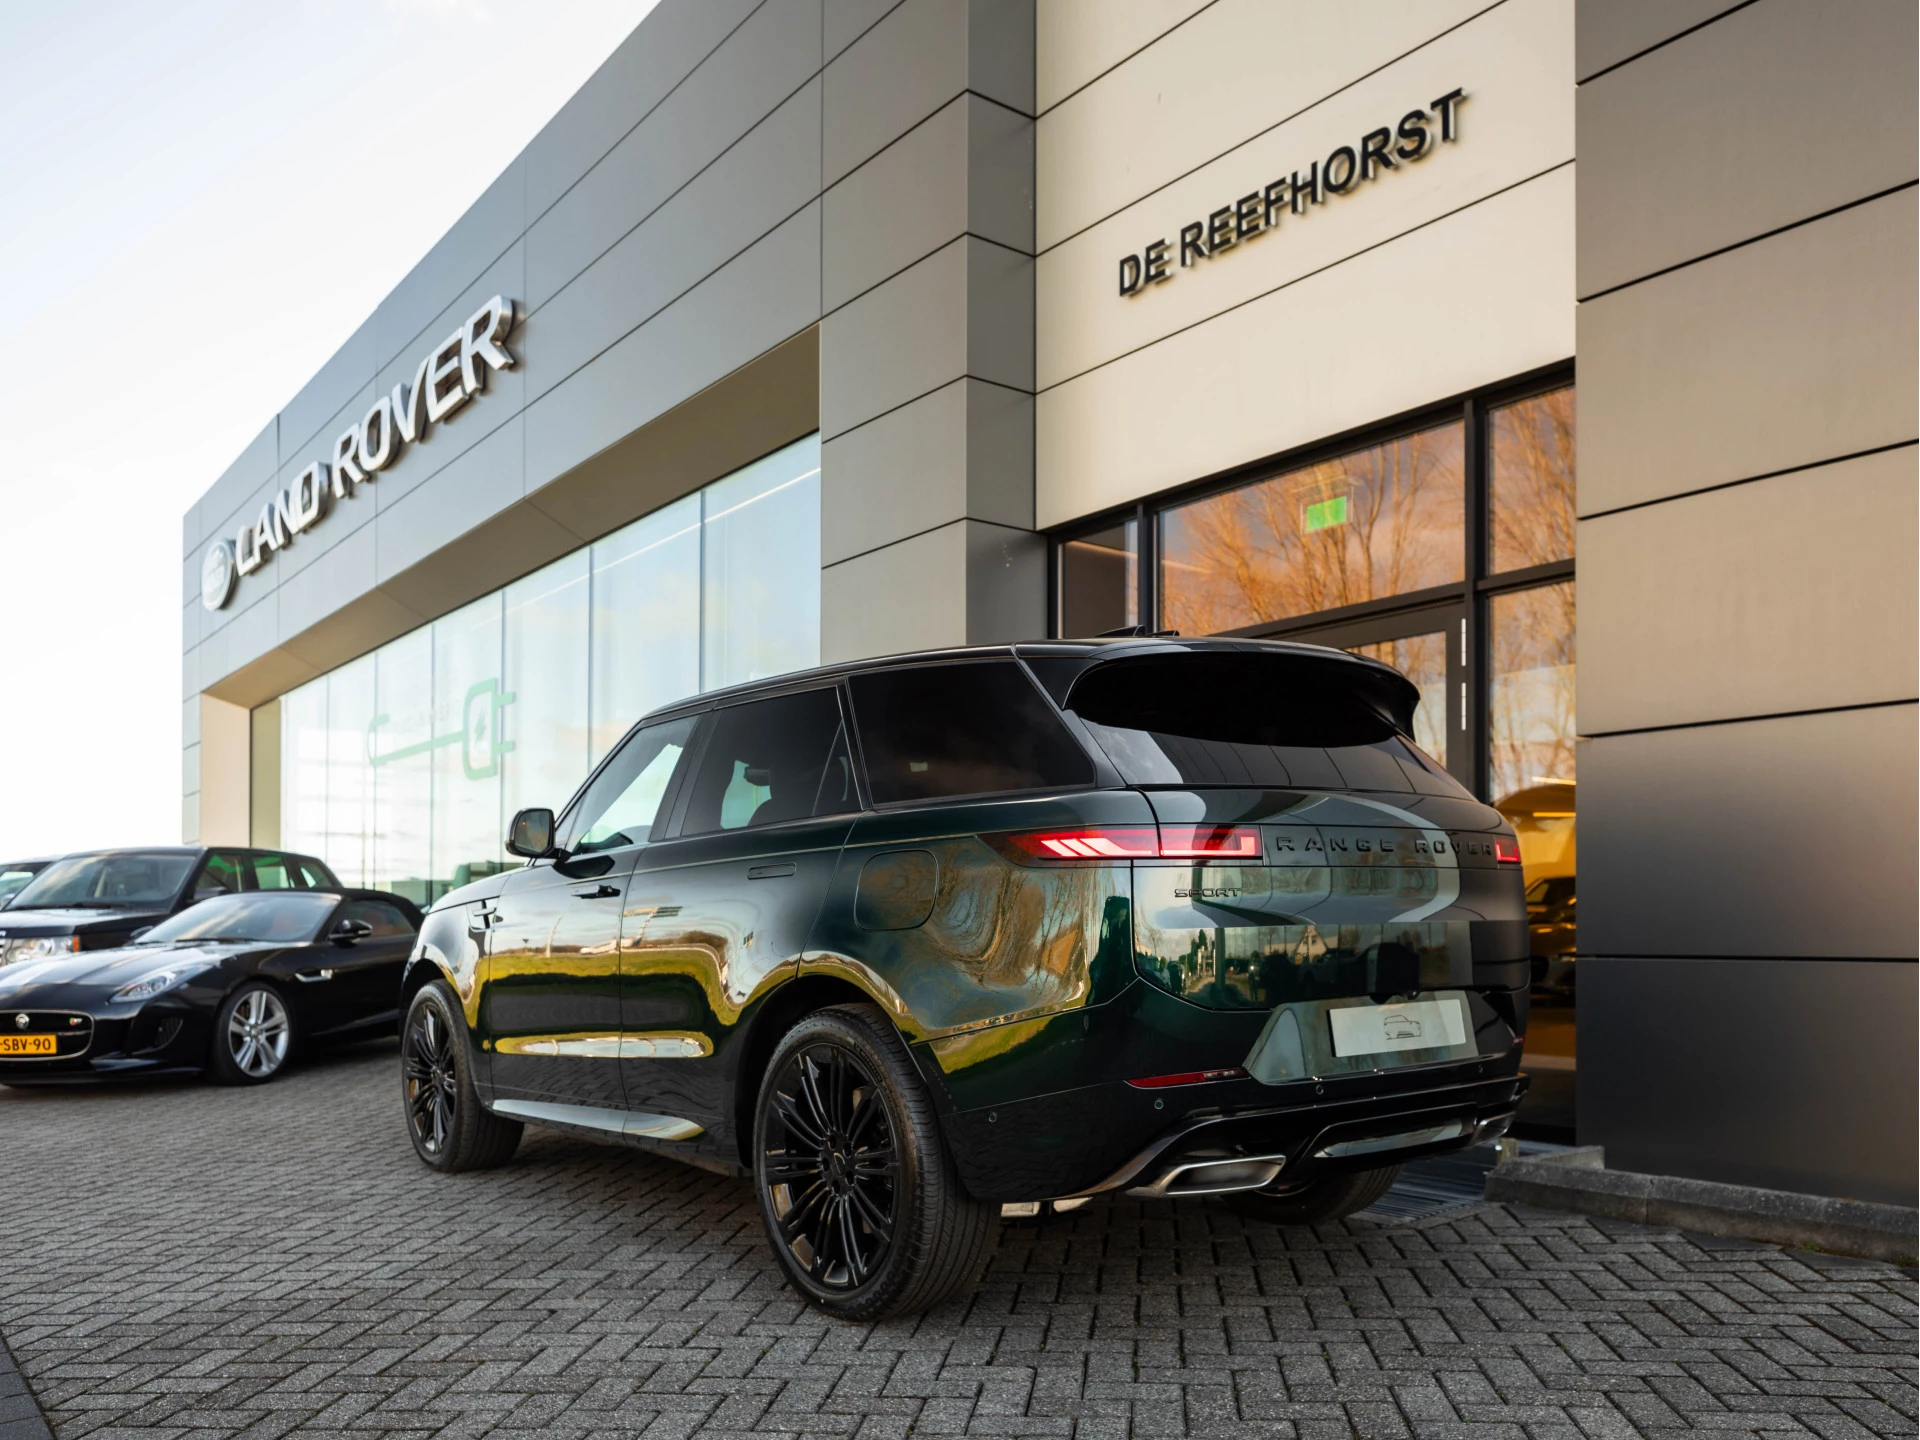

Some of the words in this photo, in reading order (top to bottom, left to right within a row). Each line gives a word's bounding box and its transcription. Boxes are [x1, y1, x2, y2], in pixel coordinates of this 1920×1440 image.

[1119, 237, 1171, 297] DE
[1180, 86, 1467, 268] REEFHORST
[235, 460, 330, 577] LAND
[331, 294, 516, 499] ROVER
[1174, 887, 1242, 898] SPORT
[1275, 836, 1395, 853] RANGE
[1414, 838, 1493, 857] ROVER
